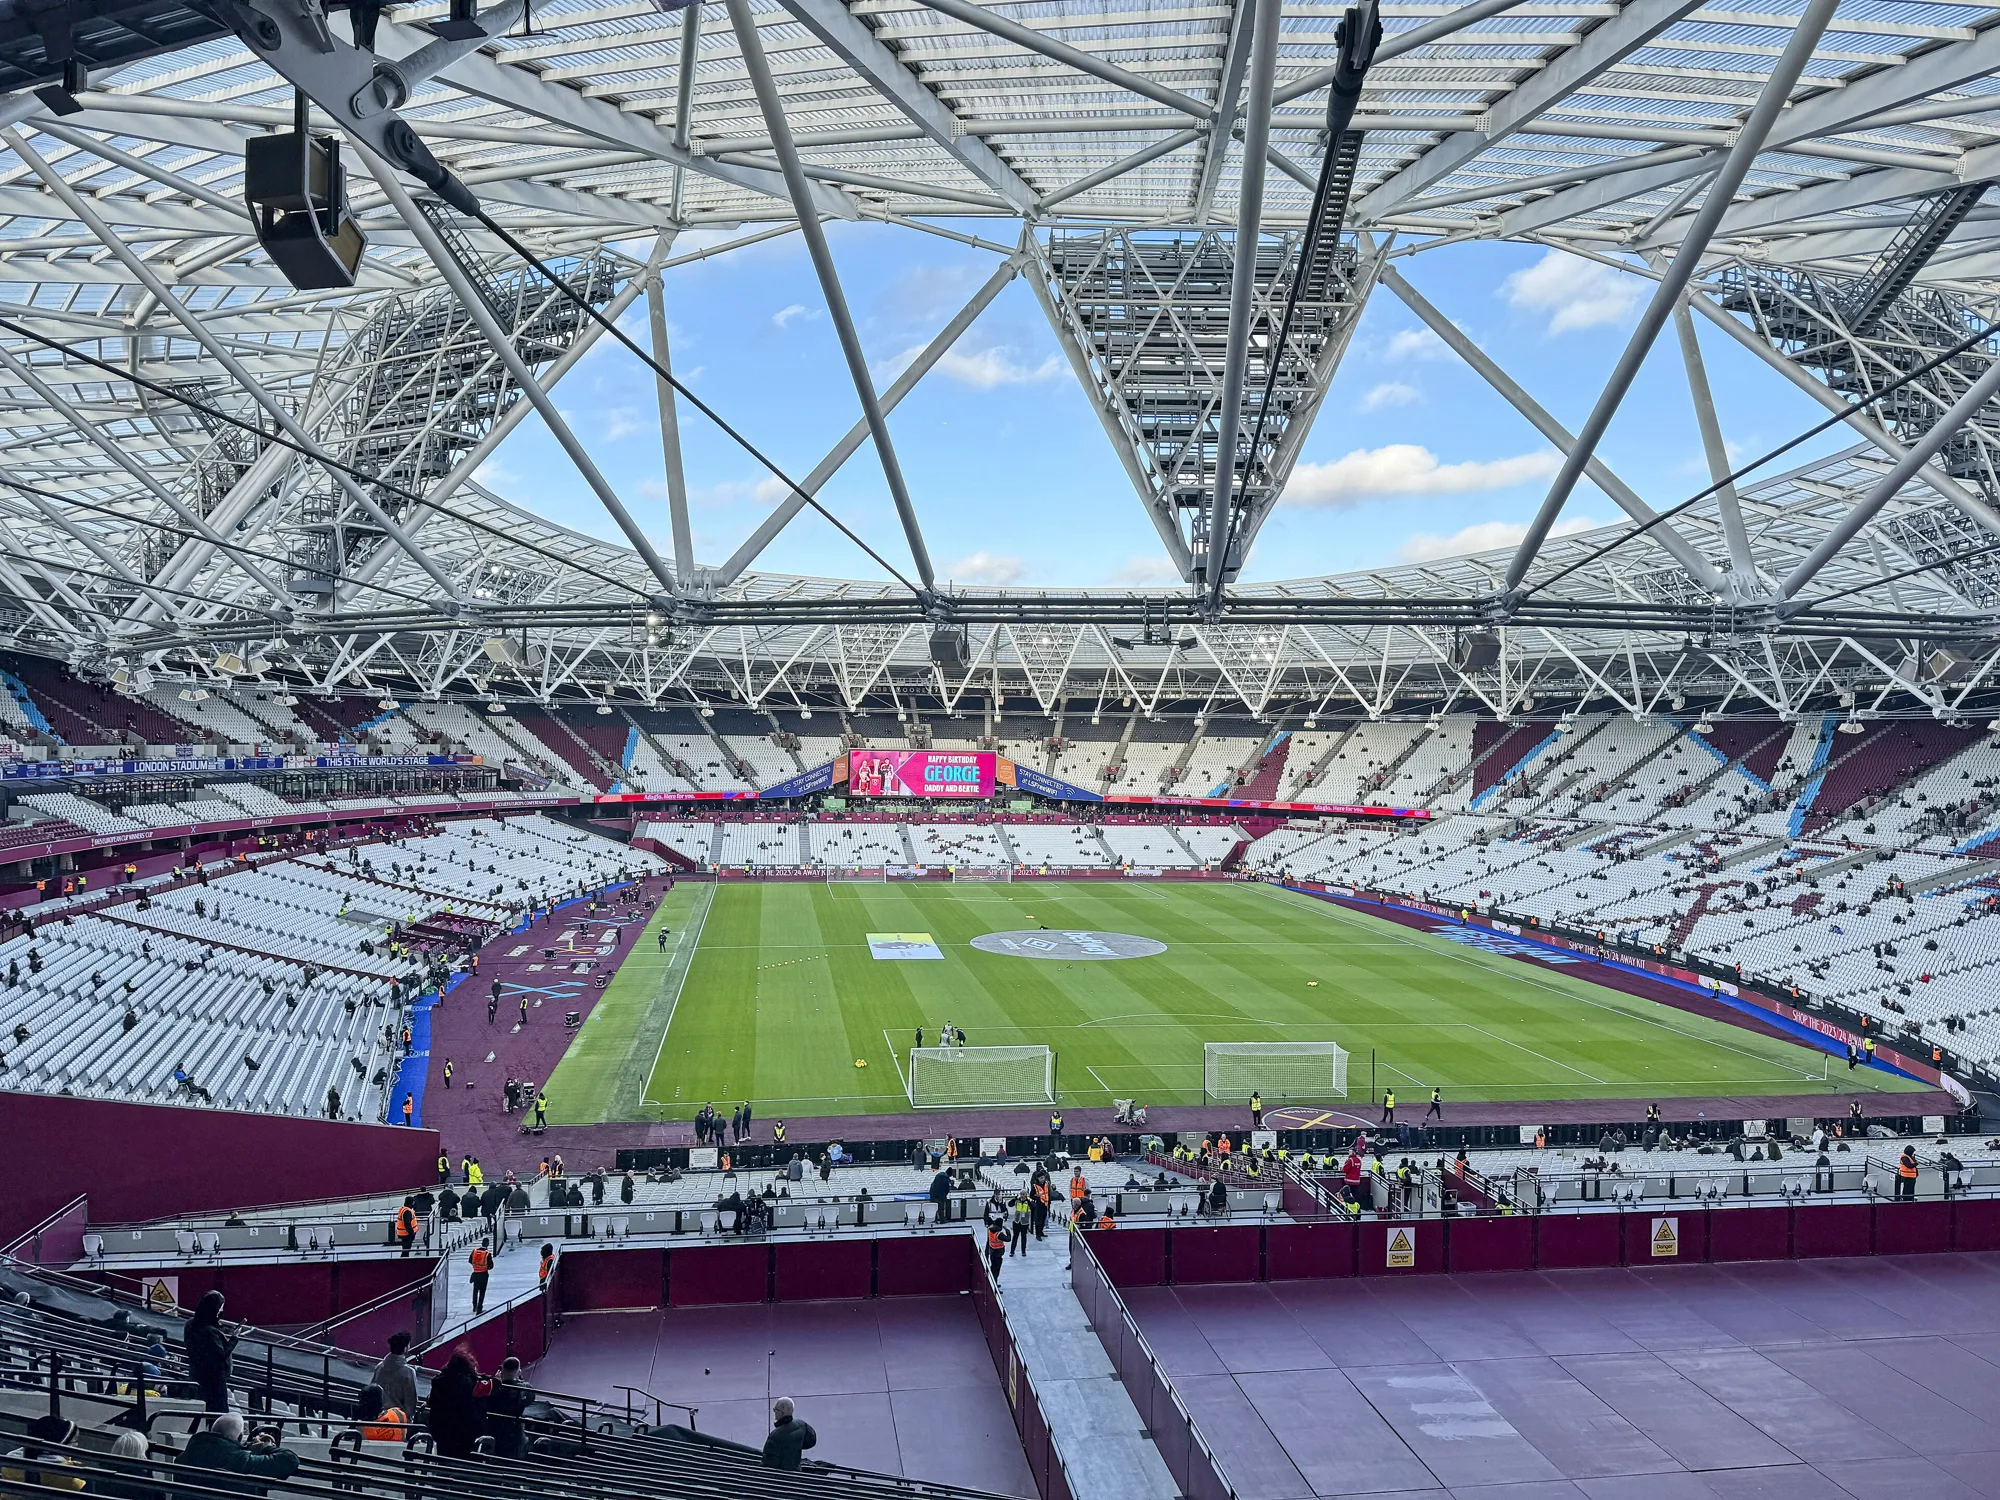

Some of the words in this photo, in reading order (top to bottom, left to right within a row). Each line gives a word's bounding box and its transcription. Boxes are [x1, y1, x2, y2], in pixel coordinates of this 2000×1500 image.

[134, 762, 169, 772] LONDON
[171, 760, 208, 771] STADIUM
[326, 758, 341, 766] THIS
[343, 757, 350, 766] IS
[352, 757, 367, 766] THE
[368, 757, 404, 765] WORLD'S
[404, 756, 428, 765] STAGE
[928, 755, 947, 763] HAPPY
[948, 755, 977, 764] BIRTHDAY
[793, 778, 804, 787] STAY
[805, 766, 830, 781] CONNECTED
[925, 766, 980, 782] GEORGE
[959, 785, 979, 793] BERTIE
[1033, 774, 1064, 790] CONNECTED
[1569, 941, 1584, 951] SHOP
[1585, 945, 1595, 956] THE
[1793, 1010, 1808, 1026] SHOP
[1809, 1018, 1820, 1032] THE
